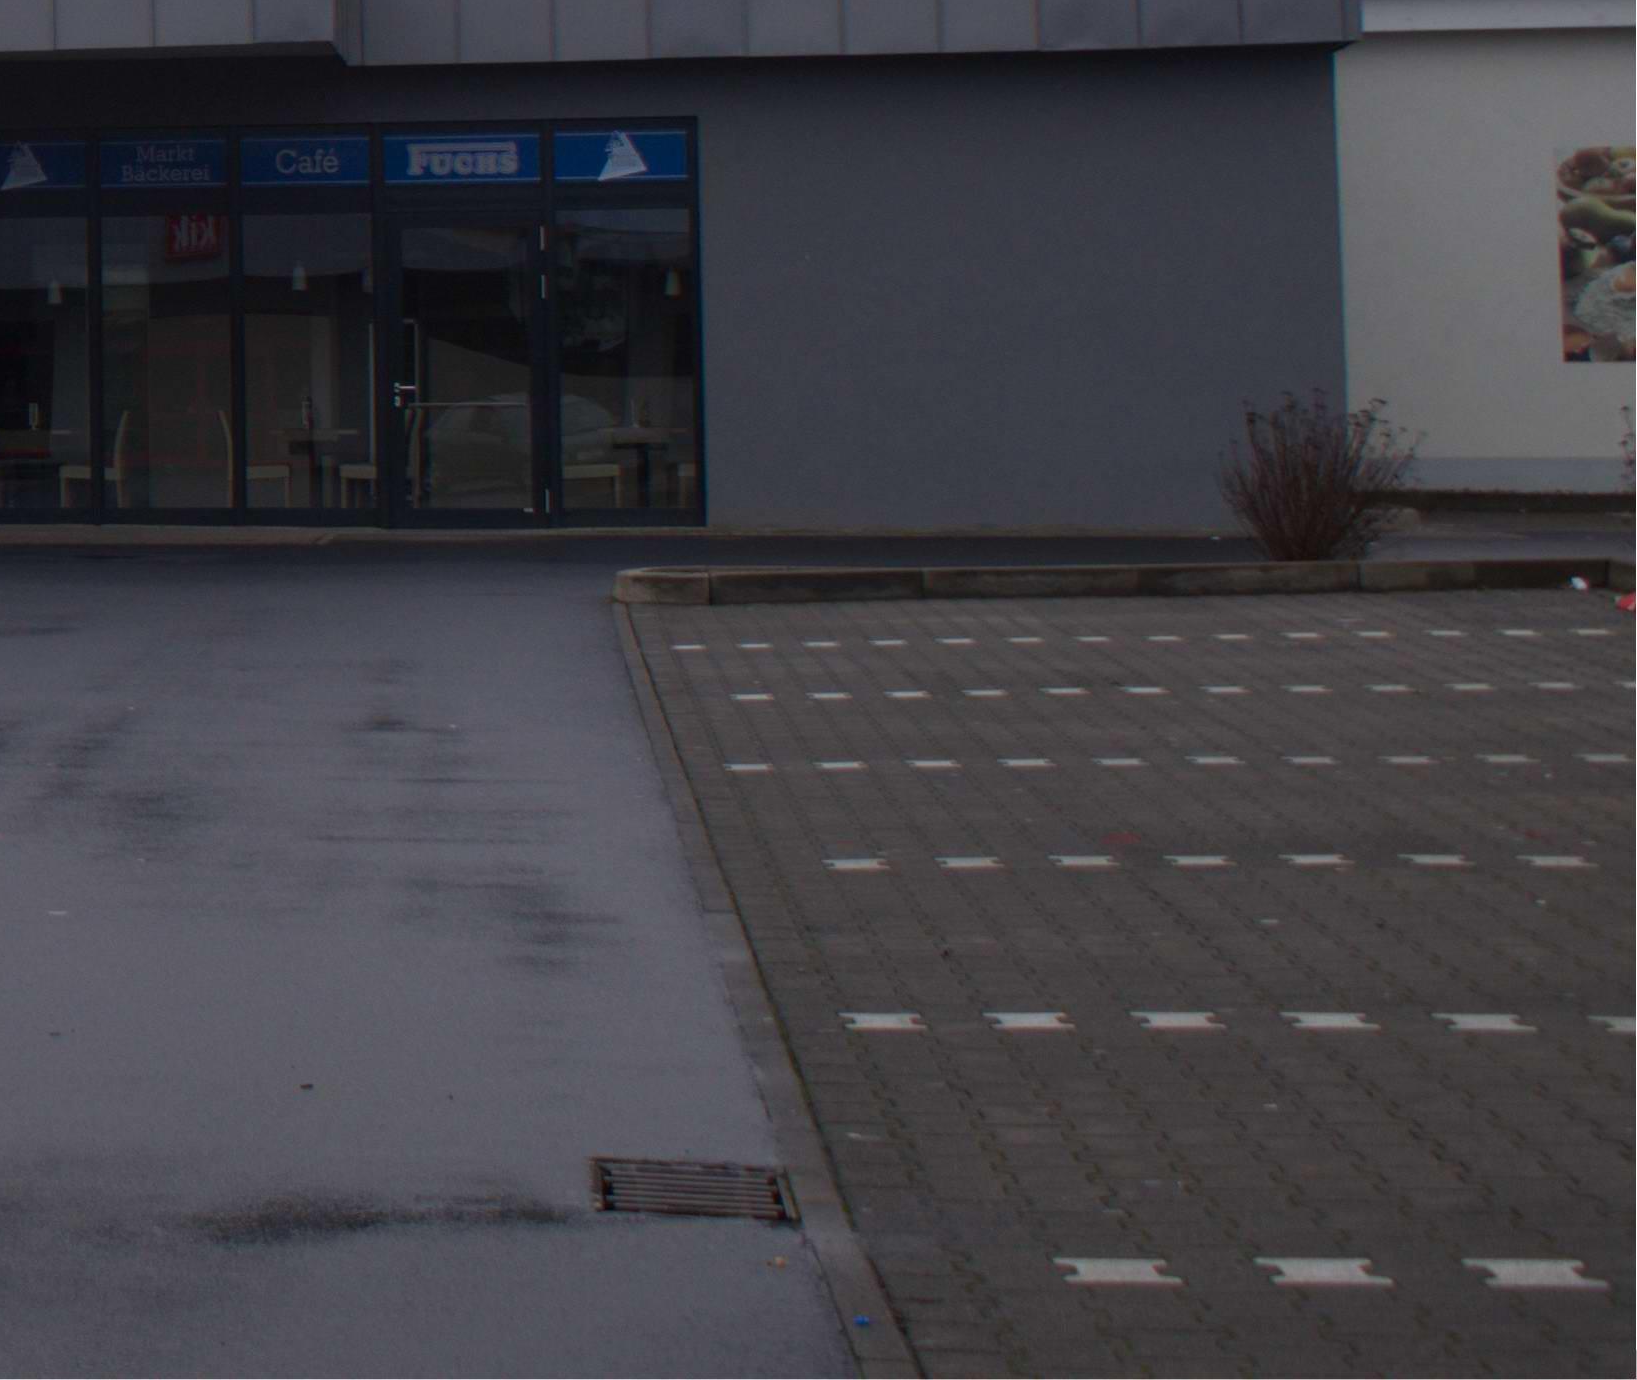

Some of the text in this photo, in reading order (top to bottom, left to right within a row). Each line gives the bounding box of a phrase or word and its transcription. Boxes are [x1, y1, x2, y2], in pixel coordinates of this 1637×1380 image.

[135, 144, 196, 163] Markt
[275, 147, 341, 174] Café
[121, 163, 210, 182] Bäckerei
